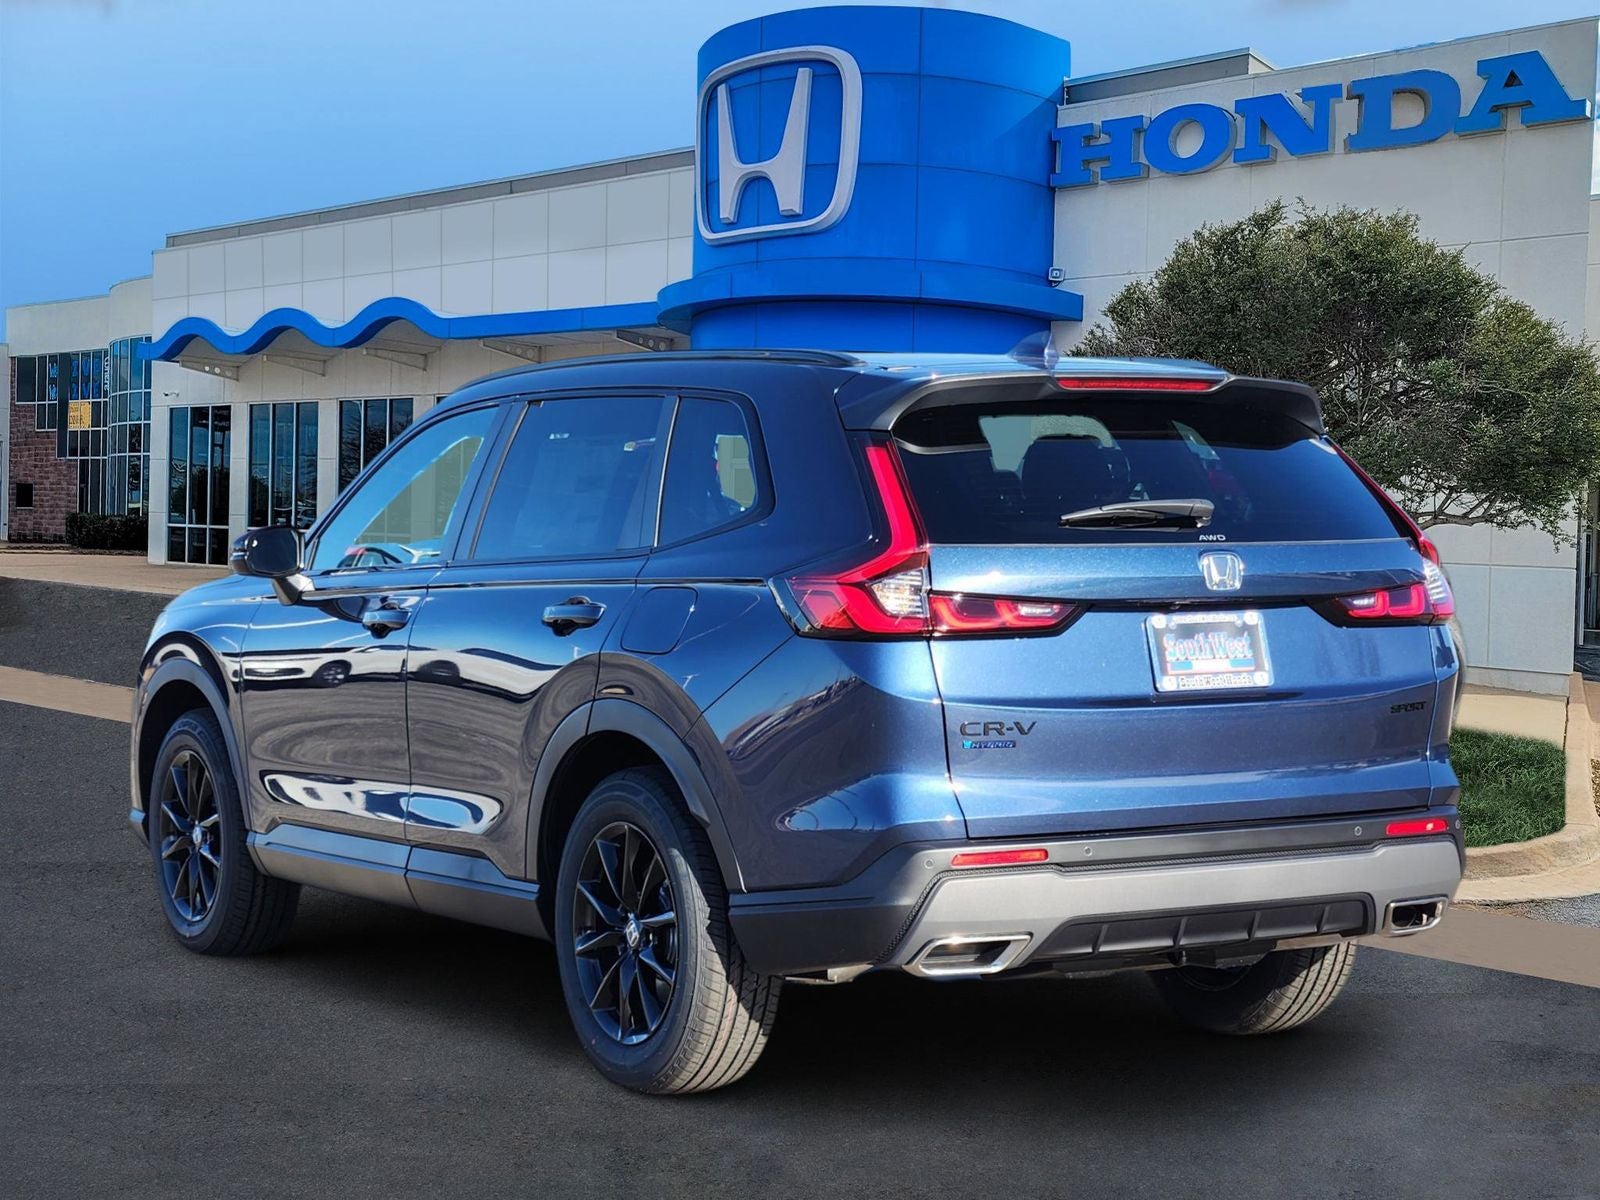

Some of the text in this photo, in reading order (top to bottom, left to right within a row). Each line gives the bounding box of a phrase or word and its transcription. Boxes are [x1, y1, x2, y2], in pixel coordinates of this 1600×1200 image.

[1050, 50, 1591, 188] HONDA
[1390, 701, 1427, 713] SPORT
[960, 721, 1037, 736] CR-V
